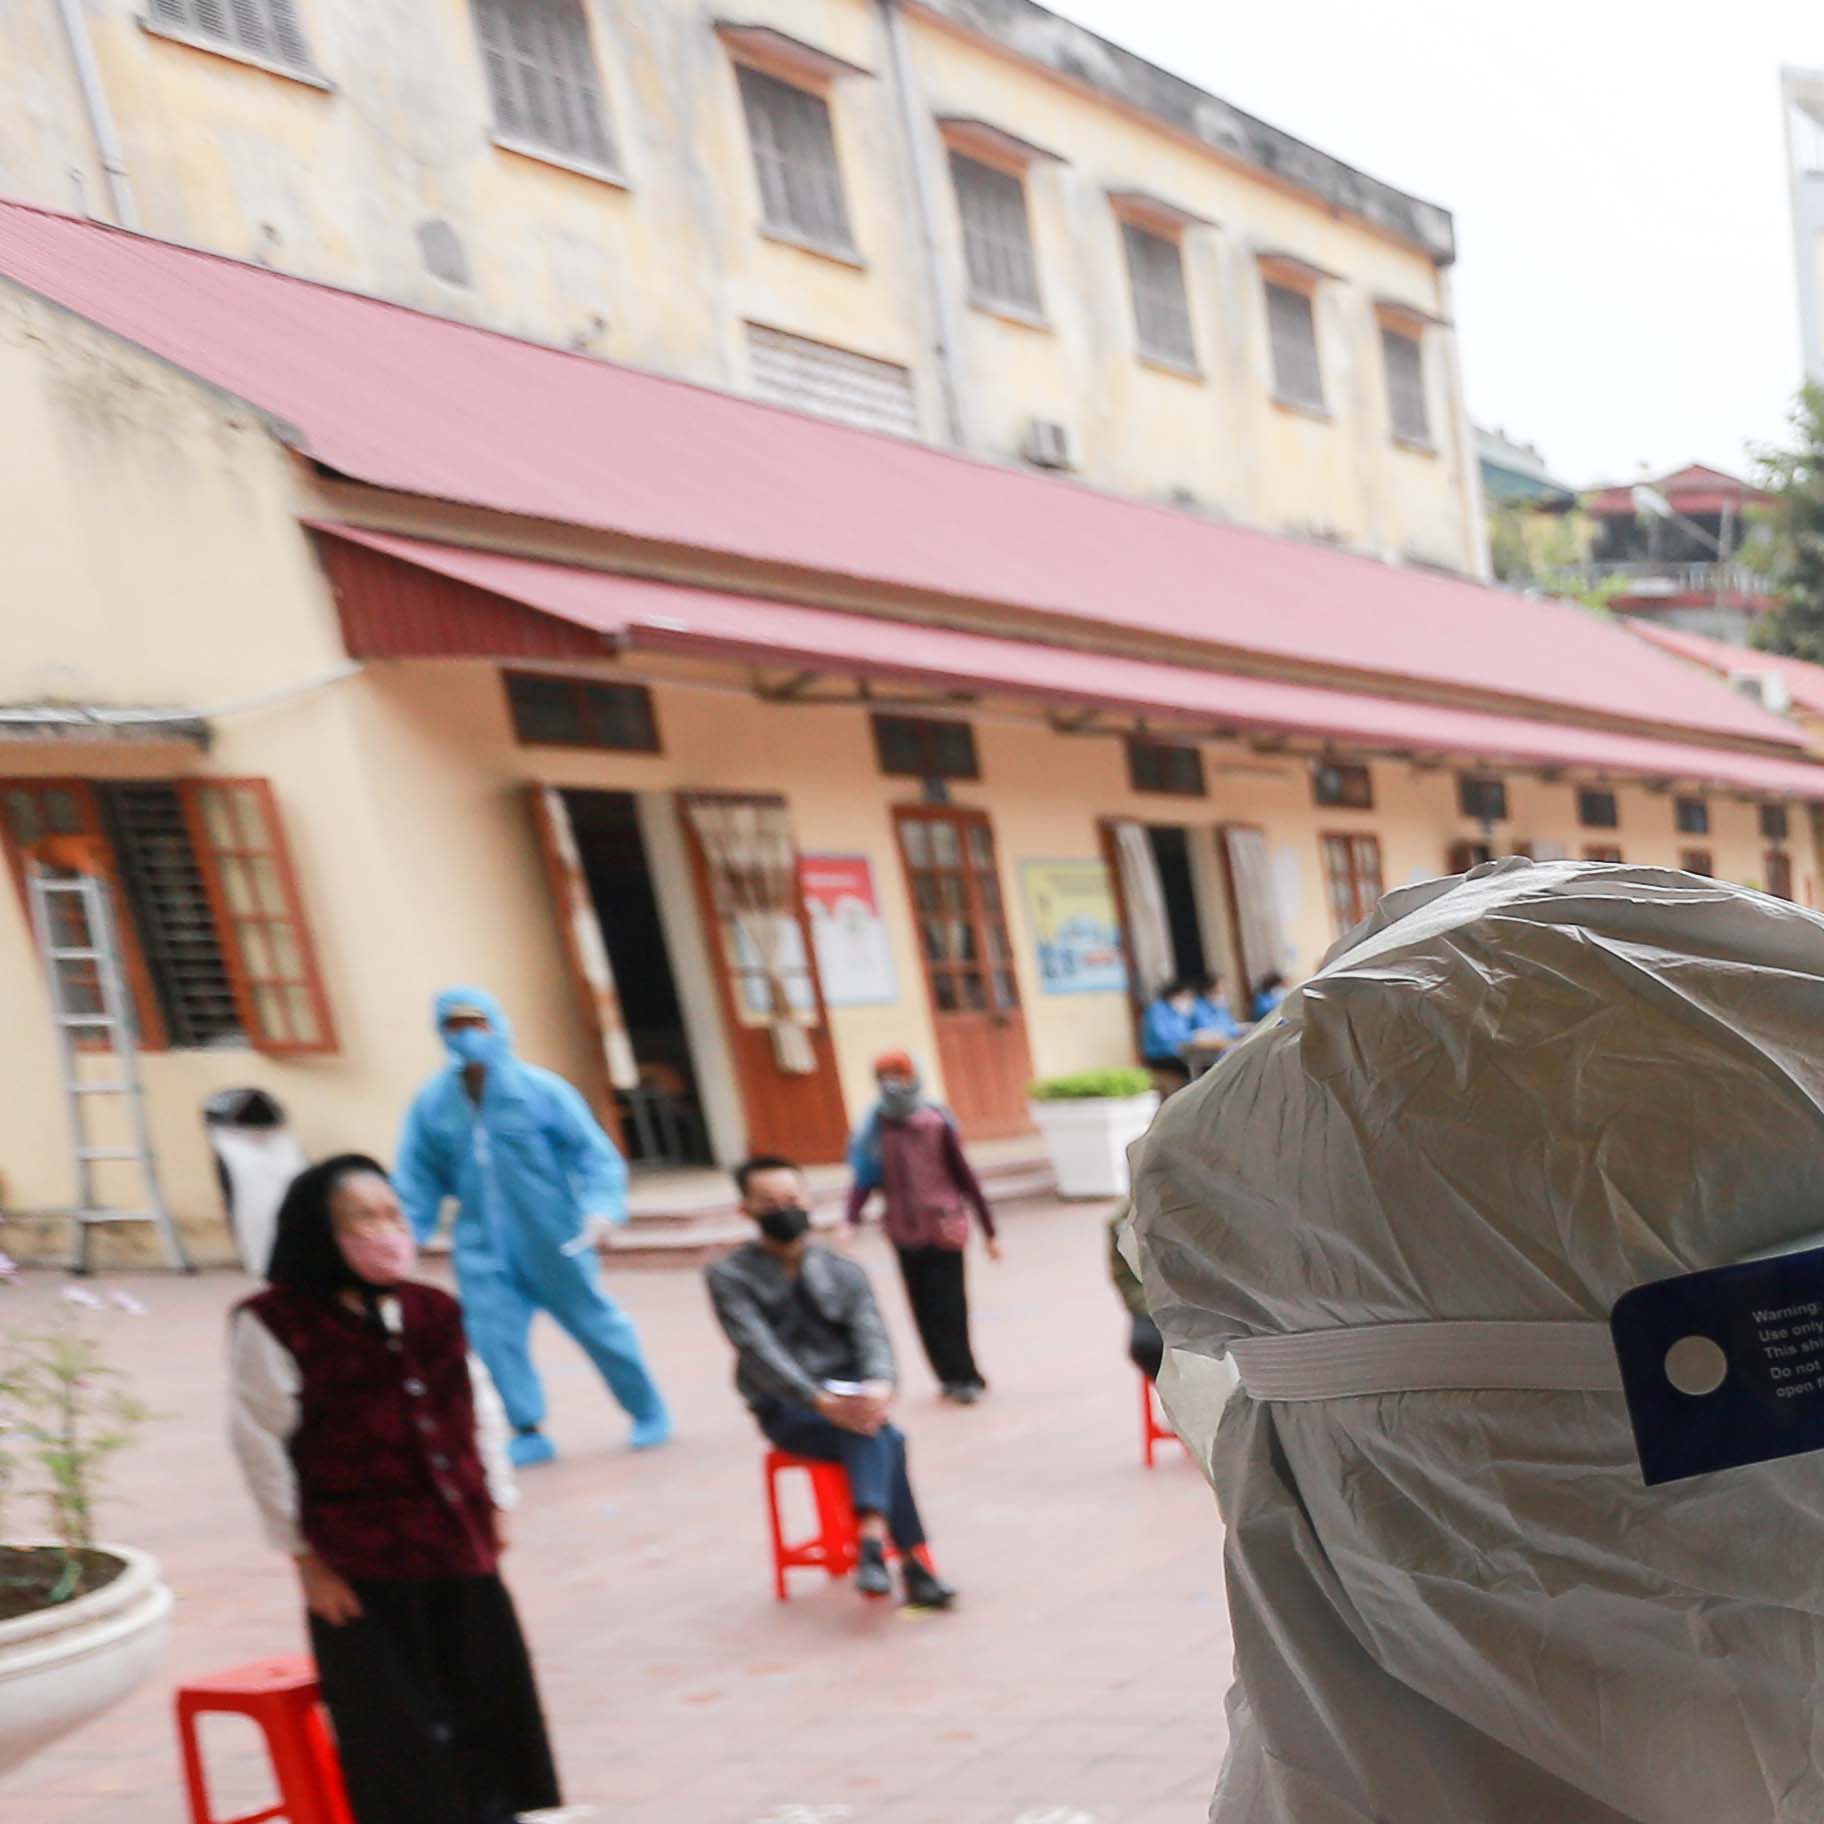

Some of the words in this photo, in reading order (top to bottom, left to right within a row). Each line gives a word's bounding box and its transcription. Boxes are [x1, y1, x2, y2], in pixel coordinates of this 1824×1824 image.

[1759, 1329, 1788, 1343] Use
[1792, 1320, 1824, 1337] only
[1763, 1344, 1797, 1360] This
[1770, 1367, 1791, 1380] Do
[1796, 1360, 1821, 1376] not
[1775, 1381, 1813, 1398] open
